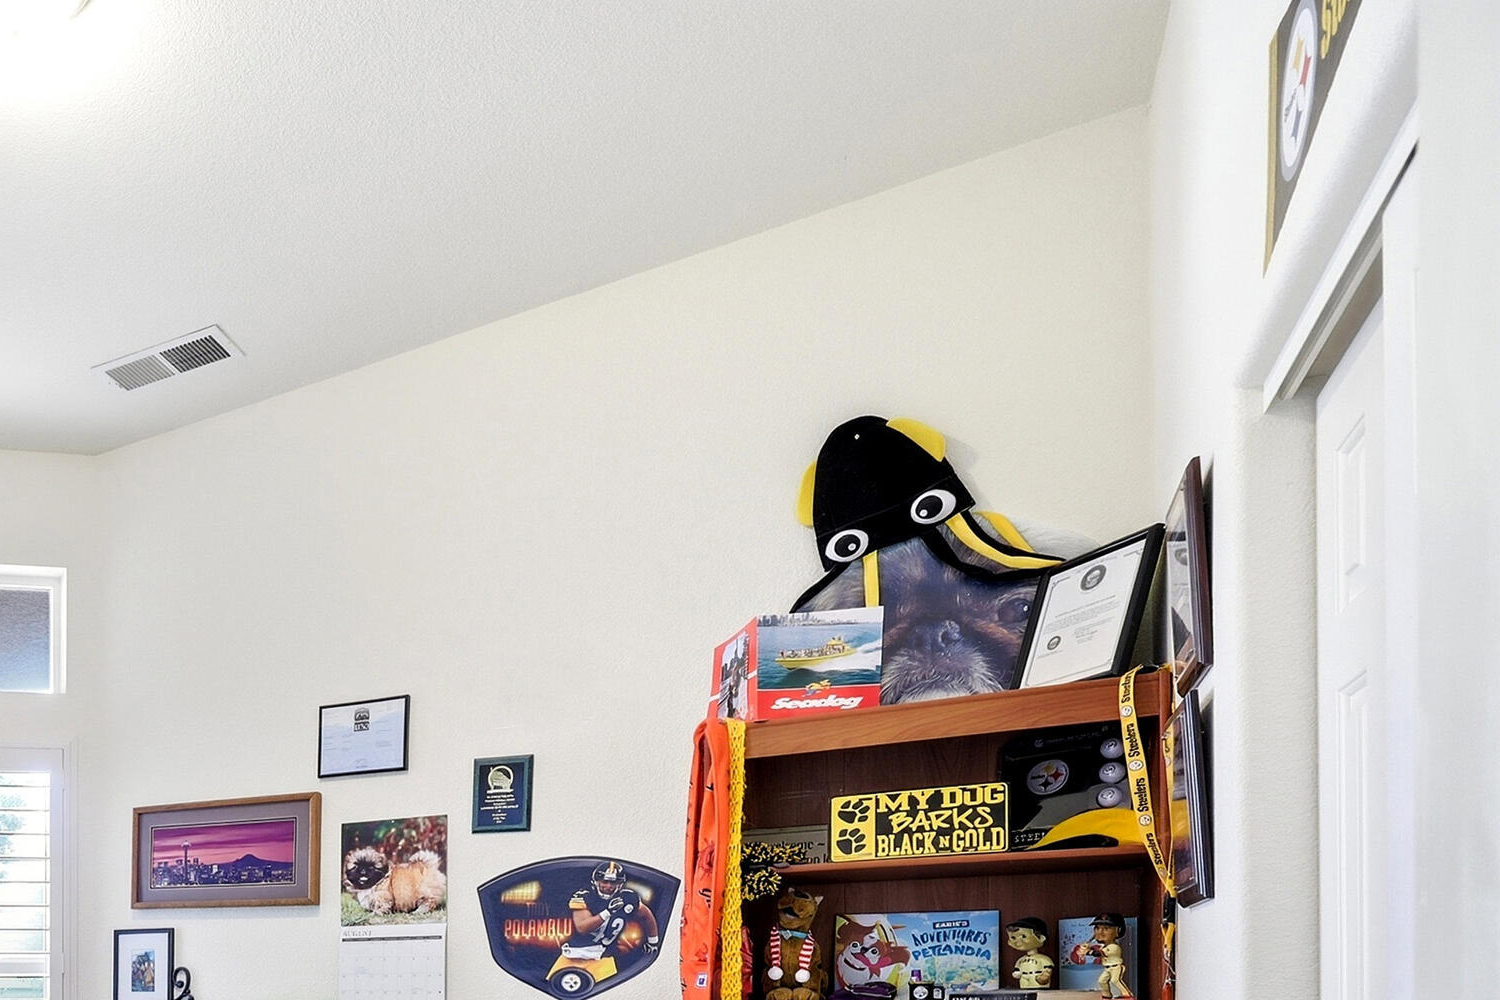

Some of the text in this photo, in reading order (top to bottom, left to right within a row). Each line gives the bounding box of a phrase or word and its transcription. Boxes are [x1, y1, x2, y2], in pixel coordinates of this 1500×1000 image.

[771, 694, 864, 710] Seadog
[1121, 671, 1135, 704] Steeler
[1128, 722, 1141, 758] Steelers
[876, 784, 1005, 814] MY DOG
[1137, 777, 1150, 812] Steelers
[888, 806, 994, 834] BARKS
[876, 826, 1005, 857] BLACK N GOLD
[911, 944, 992, 961] PETLANDIA
[912, 929, 992, 947] ADVENTURES
